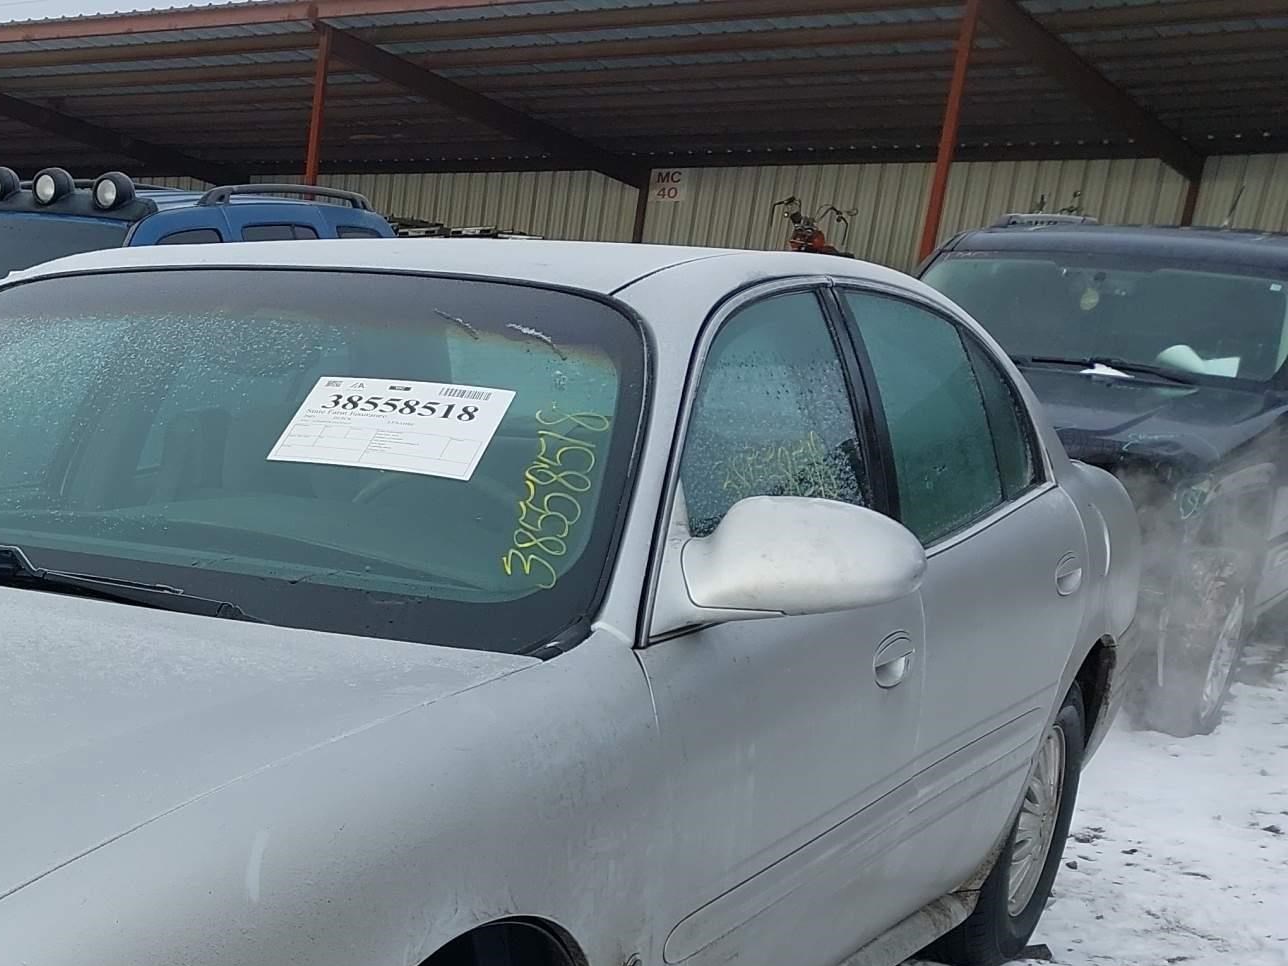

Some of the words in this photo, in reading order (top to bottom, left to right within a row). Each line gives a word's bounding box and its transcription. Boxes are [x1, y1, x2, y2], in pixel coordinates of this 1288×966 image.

[657, 171, 682, 184] MC
[656, 187, 678, 199] 40
[322, 394, 479, 422] 38558518
[502, 410, 610, 589] 38558518
